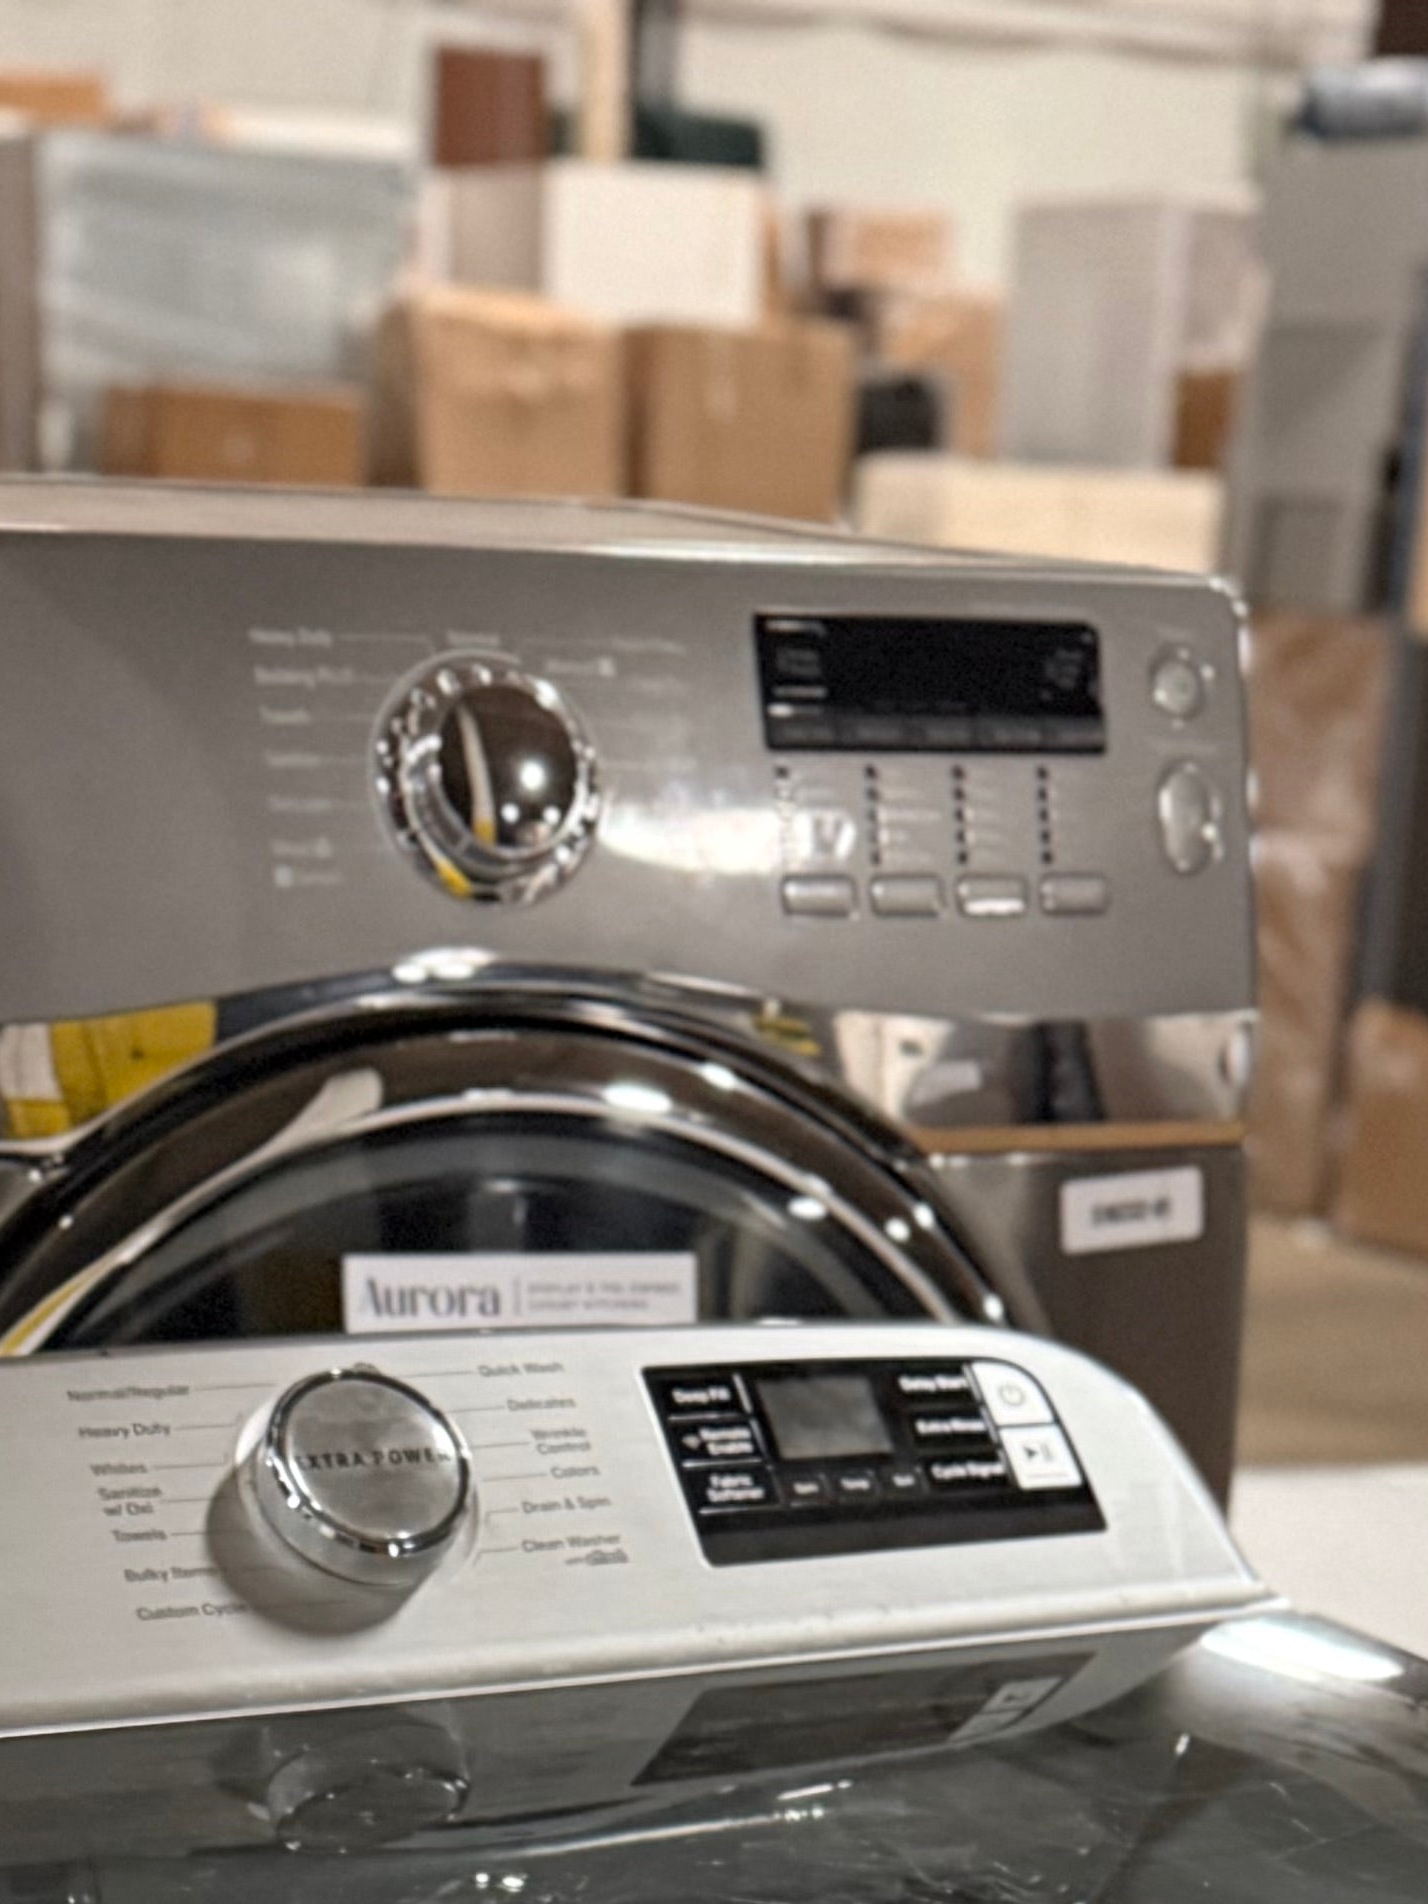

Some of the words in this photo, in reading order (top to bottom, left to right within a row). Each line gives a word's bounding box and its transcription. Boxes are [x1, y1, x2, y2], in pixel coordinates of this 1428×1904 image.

[362, 1275, 502, 1318] Aurora
[78, 1425, 130, 1439] Heavy
[131, 1423, 171, 1437] Duty
[136, 1606, 199, 1621] Custom
